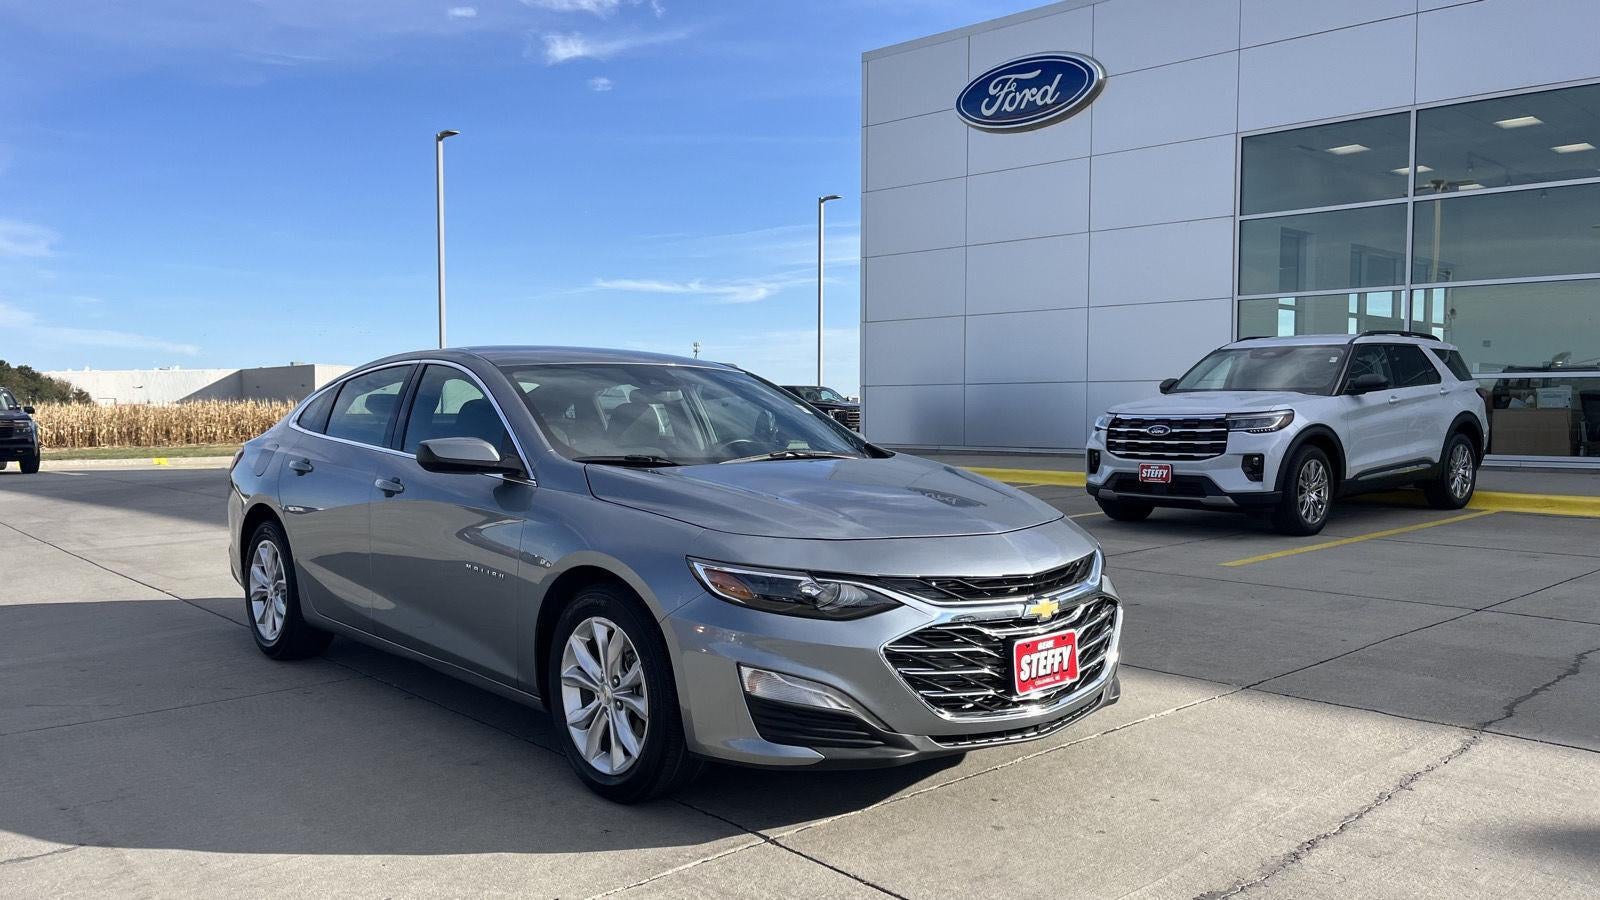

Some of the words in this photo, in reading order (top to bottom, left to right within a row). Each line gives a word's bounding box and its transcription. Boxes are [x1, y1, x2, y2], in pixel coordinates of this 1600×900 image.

[980, 69, 1063, 117] Ford
[1141, 469, 1168, 478] STEFFY
[1020, 645, 1073, 682] STEFFY
